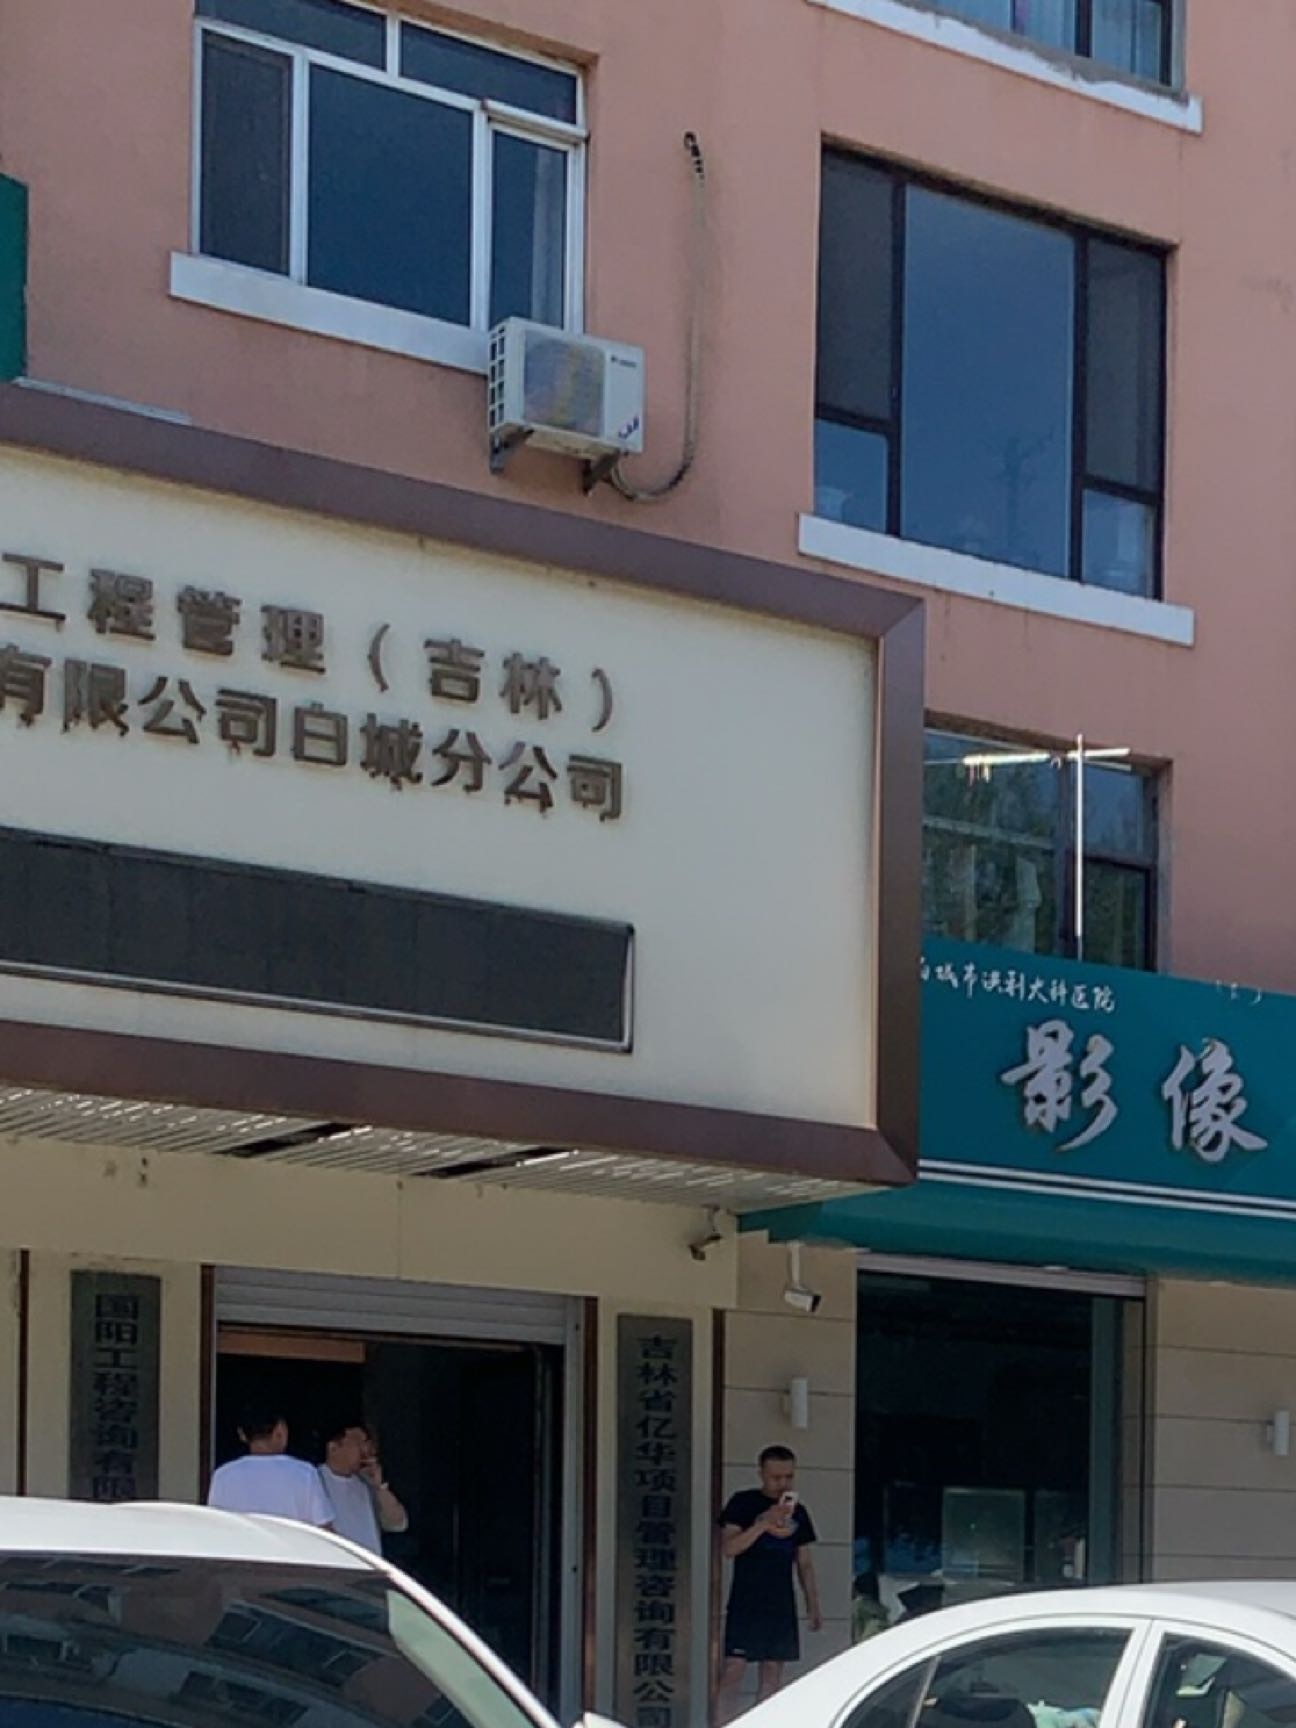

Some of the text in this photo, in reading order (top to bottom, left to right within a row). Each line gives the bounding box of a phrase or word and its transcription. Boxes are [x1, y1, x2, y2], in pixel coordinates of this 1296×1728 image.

[0, 643, 624, 821] 有限公司白城分公司
